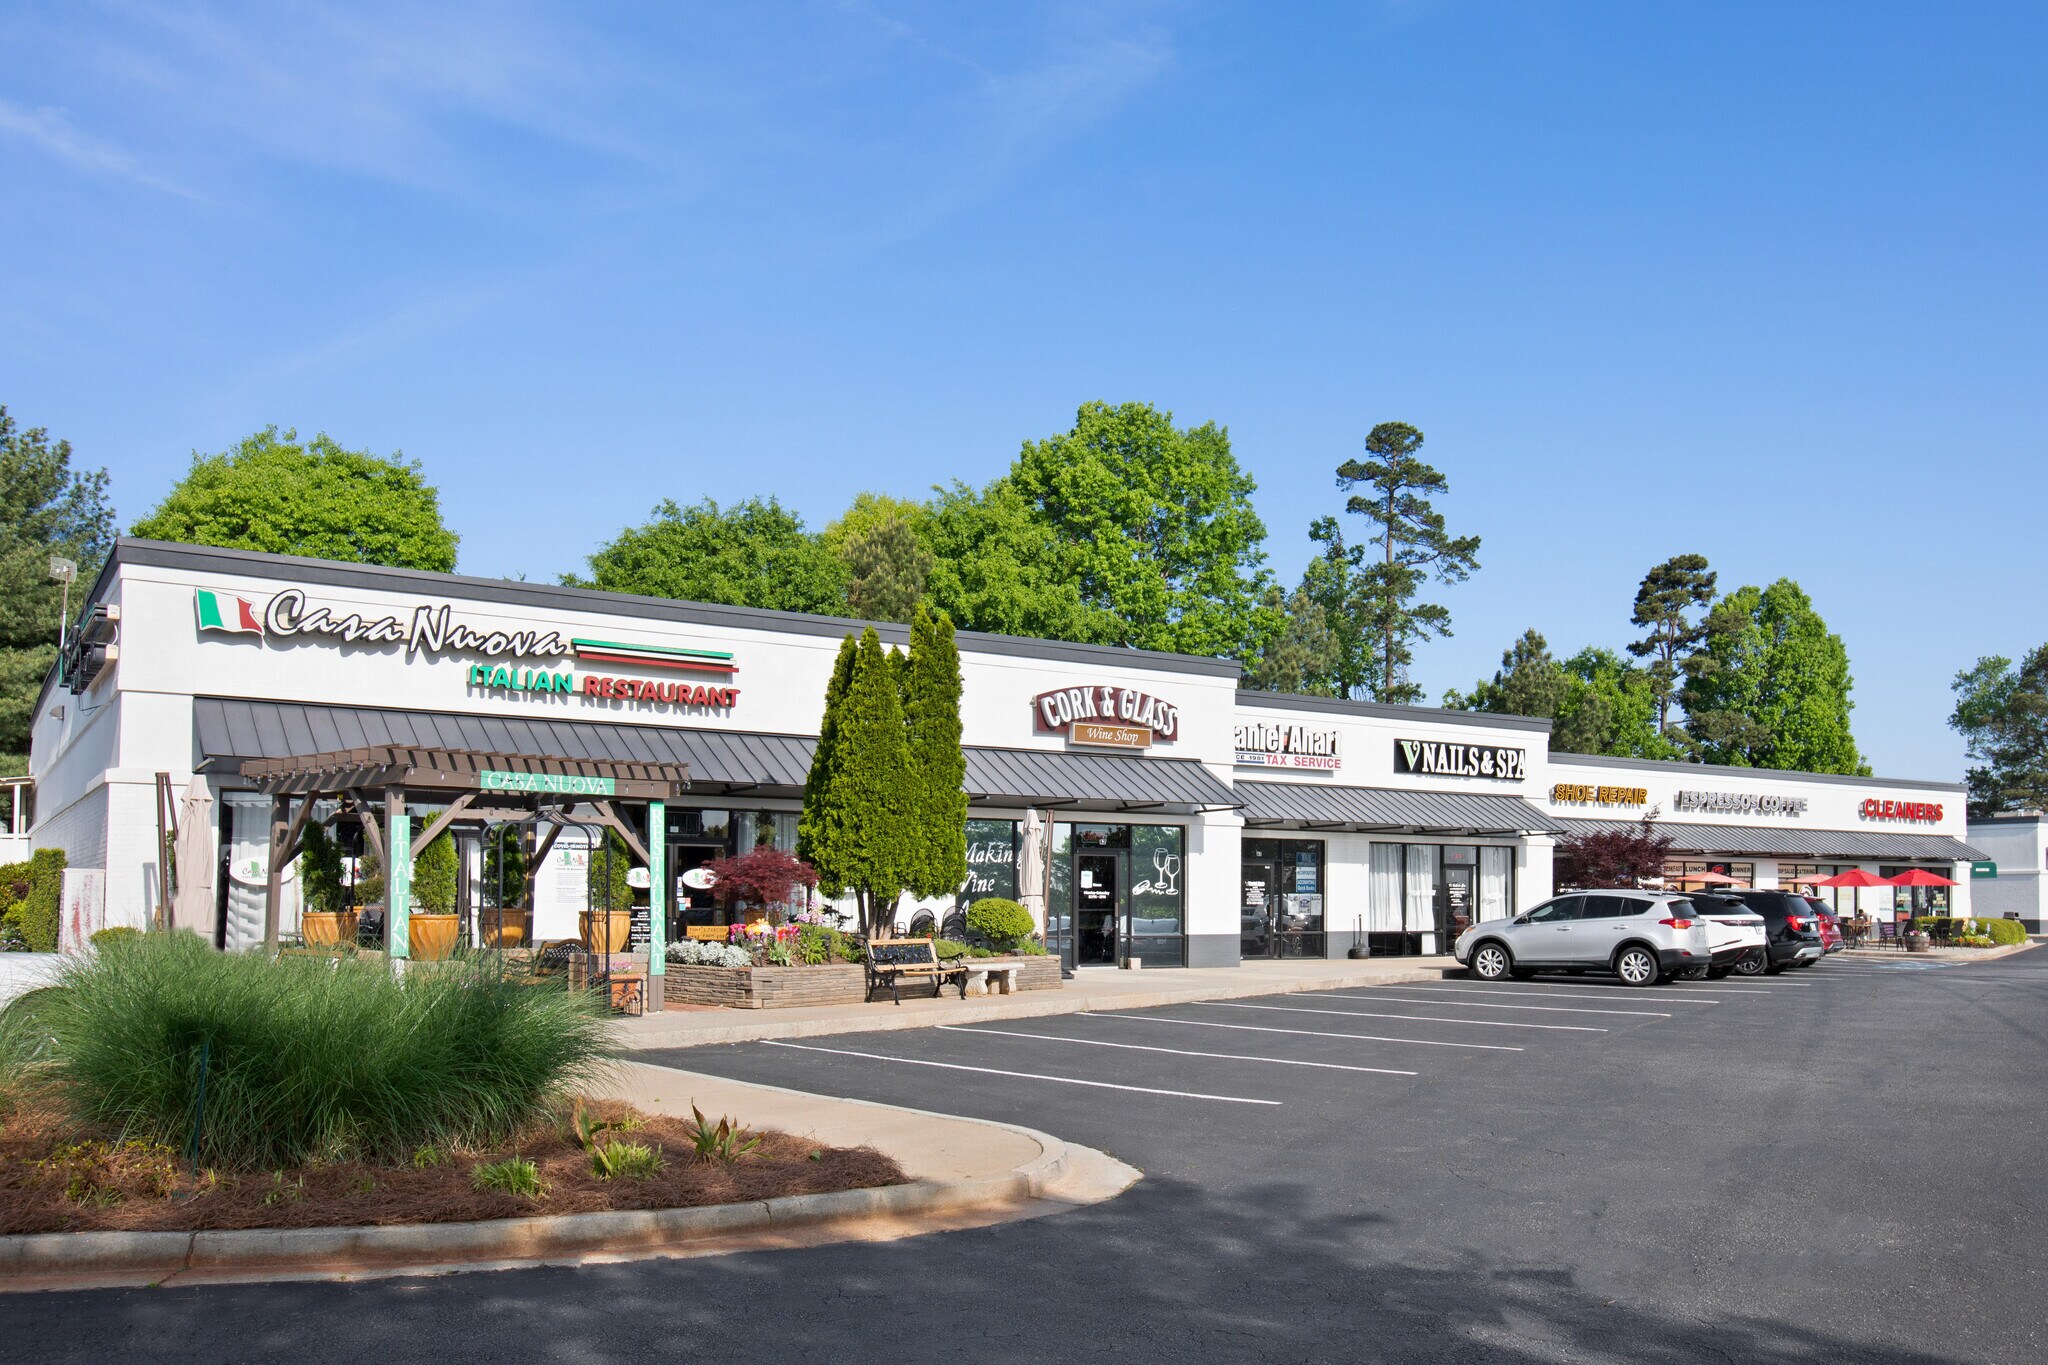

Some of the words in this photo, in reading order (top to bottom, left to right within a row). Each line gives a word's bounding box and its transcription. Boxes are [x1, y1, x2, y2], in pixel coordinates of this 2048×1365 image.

[265, 588, 404, 643] Casa
[409, 604, 567, 658] Nuova
[470, 664, 573, 694] ITALIAN
[583, 675, 741, 708] RESTAURANT
[1040, 686, 1098, 727] CORK
[1100, 686, 1115, 718] &
[1118, 689, 1178, 736] GLASS
[1086, 727, 1113, 740] Wine
[1114, 728, 1139, 745] Shop
[1235, 723, 1285, 753] aniel
[1289, 725, 1342, 755] Ahart
[1265, 754, 1288, 766] TAX
[1294, 756, 1341, 769] SERVICE
[1422, 743, 1480, 776] NAILS
[1480, 750, 1495, 775] &
[1496, 748, 1526, 779] SPA
[487, 771, 538, 791] CASA
[544, 774, 608, 795] NUOVA
[1554, 783, 1595, 801] SHOE
[1598, 785, 1648, 805] REPAIR
[1864, 798, 1944, 822] CLEANERS
[1685, 865, 1706, 873] LUNCH
[1731, 864, 1751, 873] DINNER
[392, 822, 409, 953] ITALIAN
[651, 808, 665, 969] RESTAURANT
